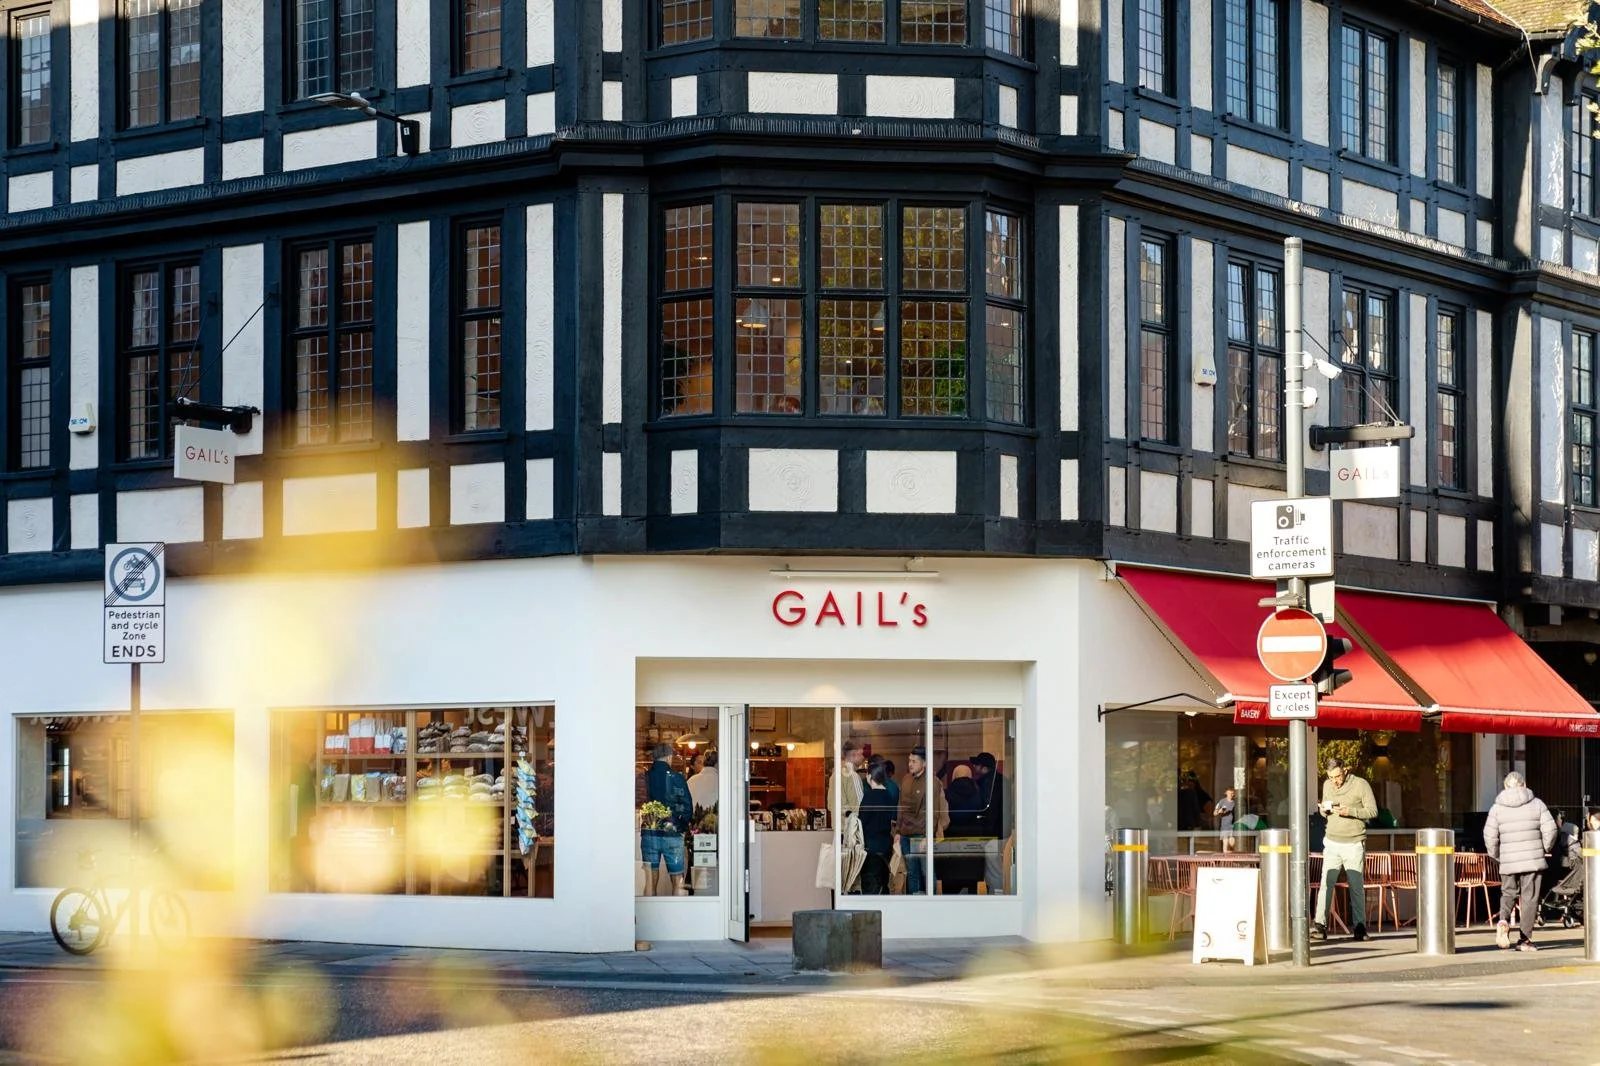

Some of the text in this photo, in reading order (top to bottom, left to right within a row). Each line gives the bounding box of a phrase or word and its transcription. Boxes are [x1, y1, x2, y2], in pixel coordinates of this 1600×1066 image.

[185, 445, 229, 465] GAIL's
[1337, 467, 1390, 482] GAILs
[1273, 535, 1310, 546] Traffic
[1256, 546, 1327, 559] enforcement
[1268, 561, 1315, 571] cameras
[771, 589, 928, 627] GAIL's
[108, 610, 160, 619] Pedestrian
[111, 621, 159, 631] and cycle
[122, 632, 146, 640] Zone
[112, 645, 156, 658] ENDS
[1274, 690, 1311, 700] Except
[1276, 702, 1310, 714] cycles
[1240, 709, 1260, 719] BAKERY
